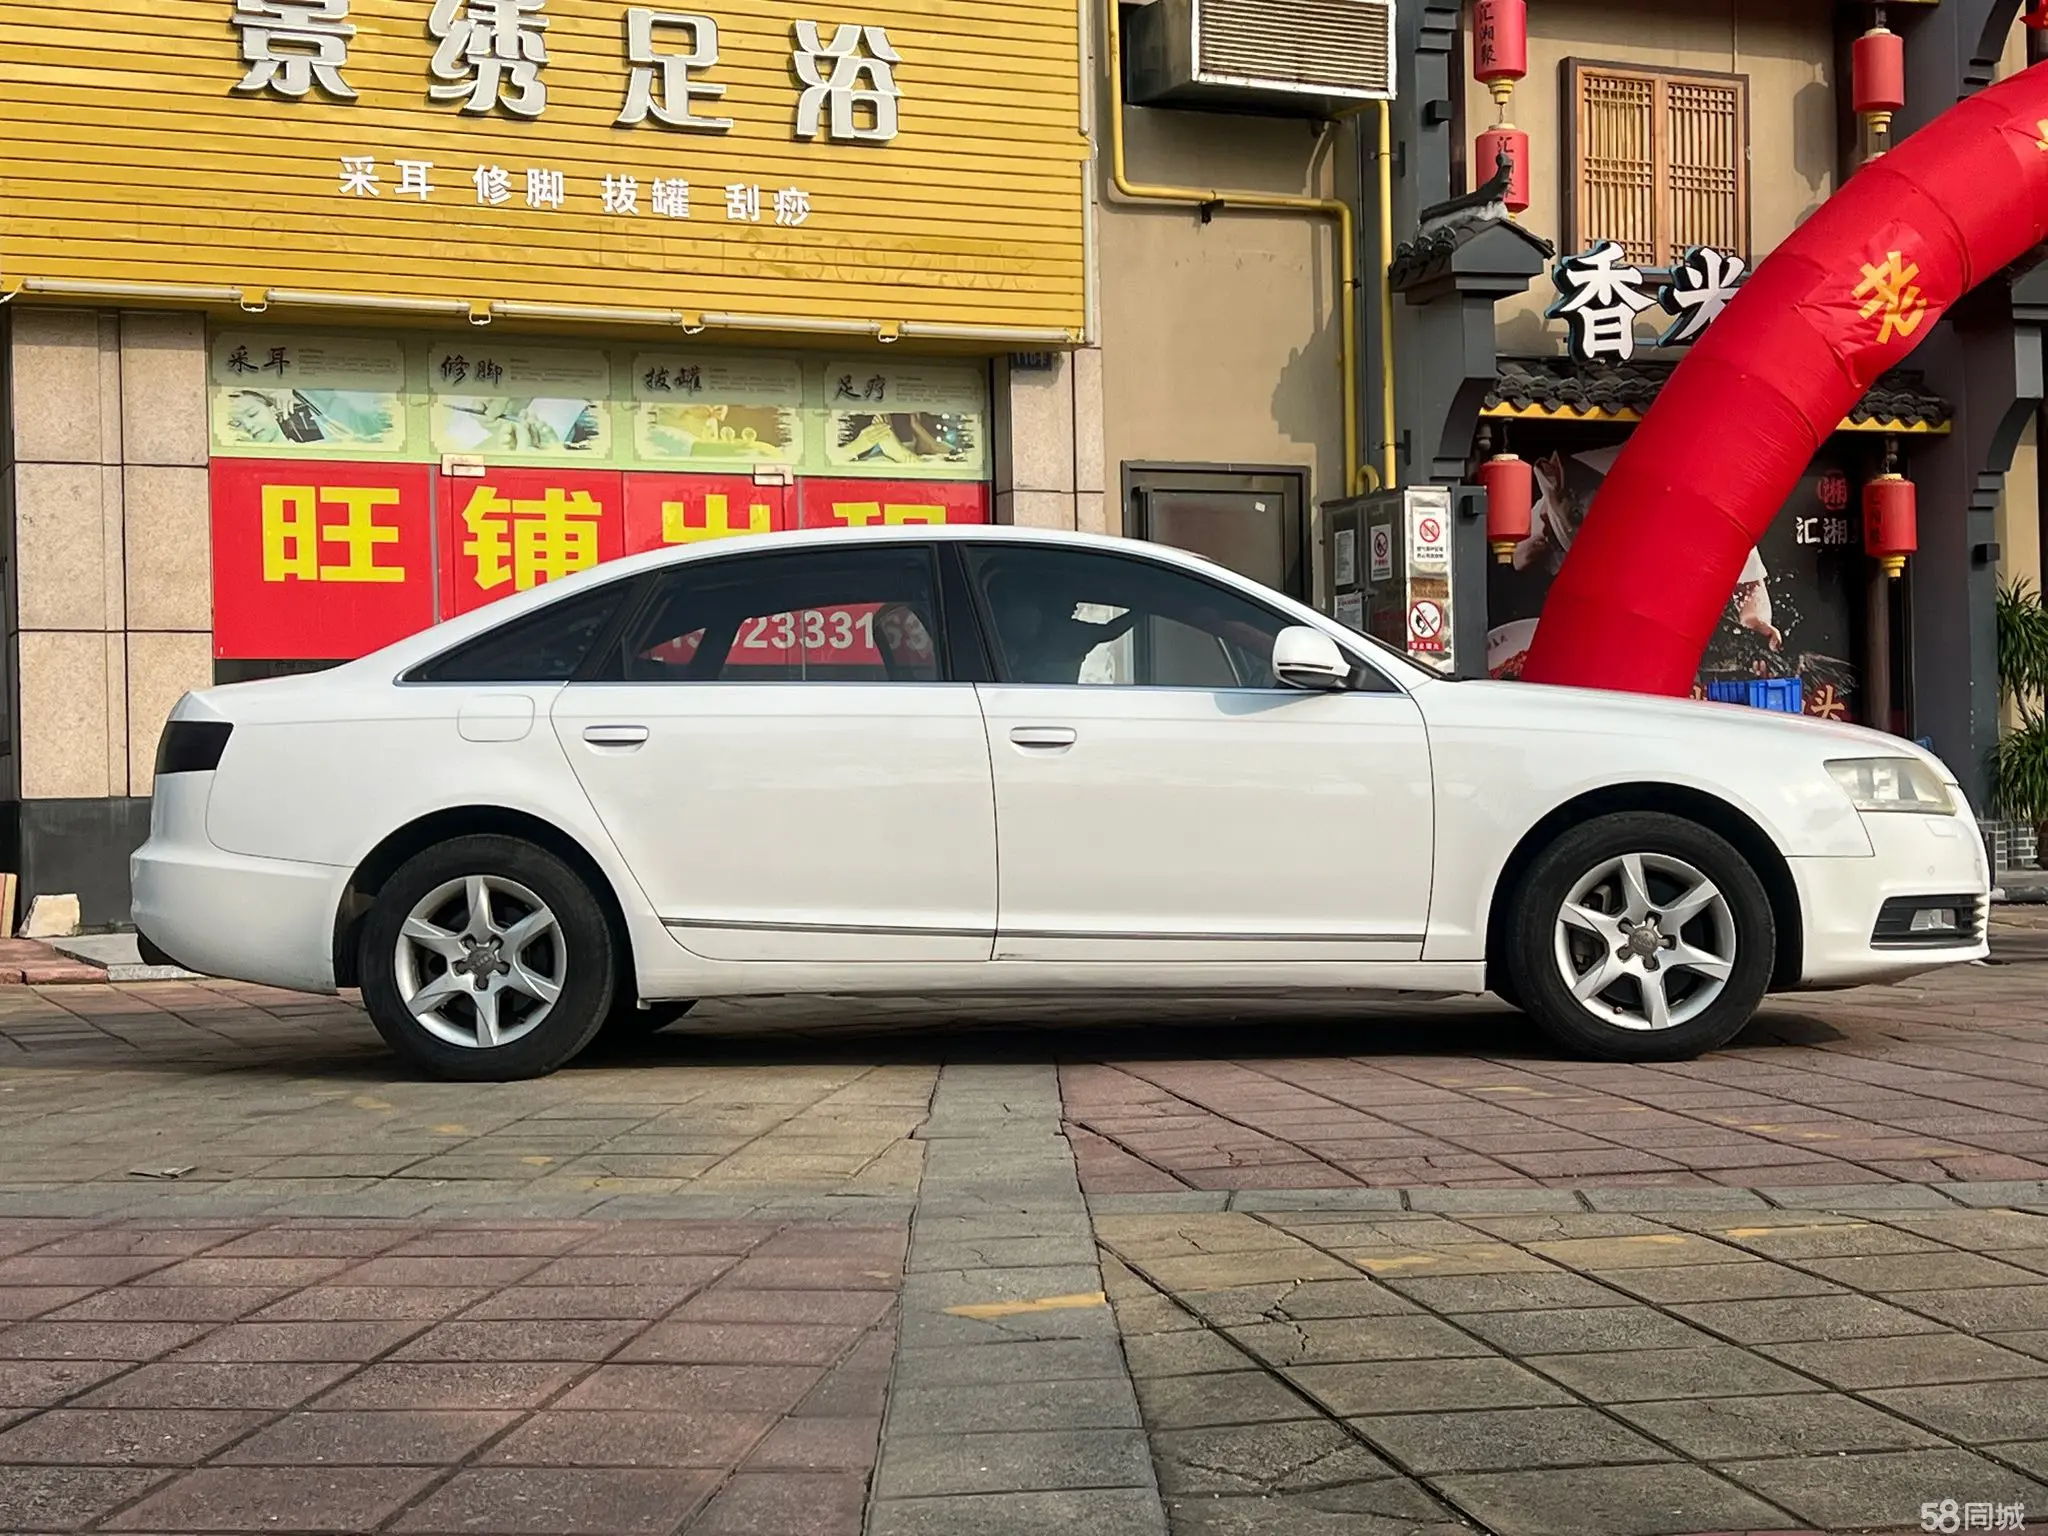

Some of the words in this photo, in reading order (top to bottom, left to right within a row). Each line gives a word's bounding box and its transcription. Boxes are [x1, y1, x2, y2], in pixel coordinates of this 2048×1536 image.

[338, 155, 436, 201] 采耳
[471, 164, 565, 210] 修脚
[600, 173, 690, 220] 拔罐
[724, 184, 811, 227] 刮痧
[227, 345, 291, 376] 采耳
[440, 354, 503, 385] 修脚
[643, 365, 704, 395] 拔罐
[835, 375, 889, 401] 足疗
